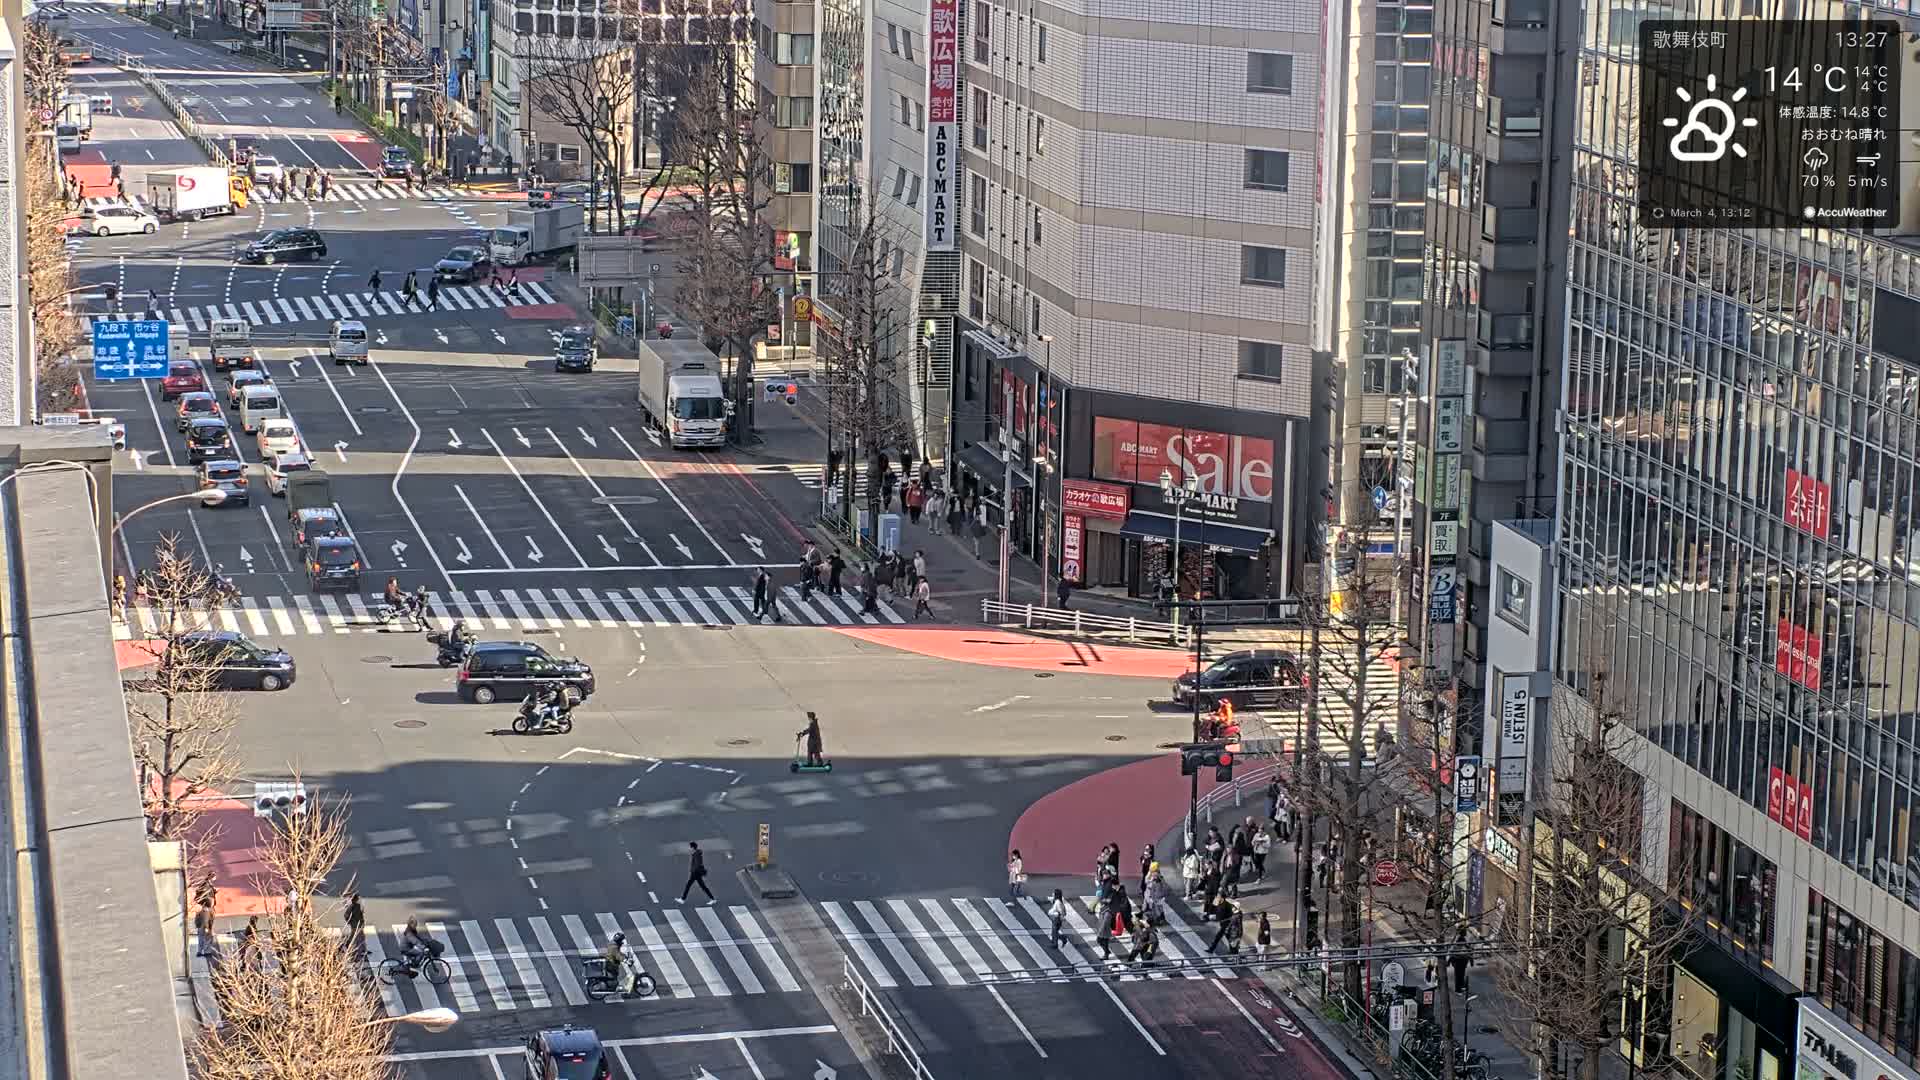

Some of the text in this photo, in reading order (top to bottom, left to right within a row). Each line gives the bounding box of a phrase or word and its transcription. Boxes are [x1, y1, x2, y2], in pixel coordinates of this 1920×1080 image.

[933, 9, 954, 89] 歌広場
[932, 108, 953, 119] 5F
[934, 125, 947, 242] ABC-MART
[100, 323, 128, 332] 九段下
[1166, 434, 1272, 499] Sale
[1065, 489, 1092, 502] カラオケ
[1100, 494, 1125, 508] 歌広場
[1439, 512, 1450, 521] 7F
[1789, 479, 1826, 529] 会計
[1434, 525, 1448, 552] 買取
[1504, 700, 1513, 738] PARK CITY
[1512, 690, 1527, 744] ISETAN 5
[1770, 777, 1809, 828] CPA
